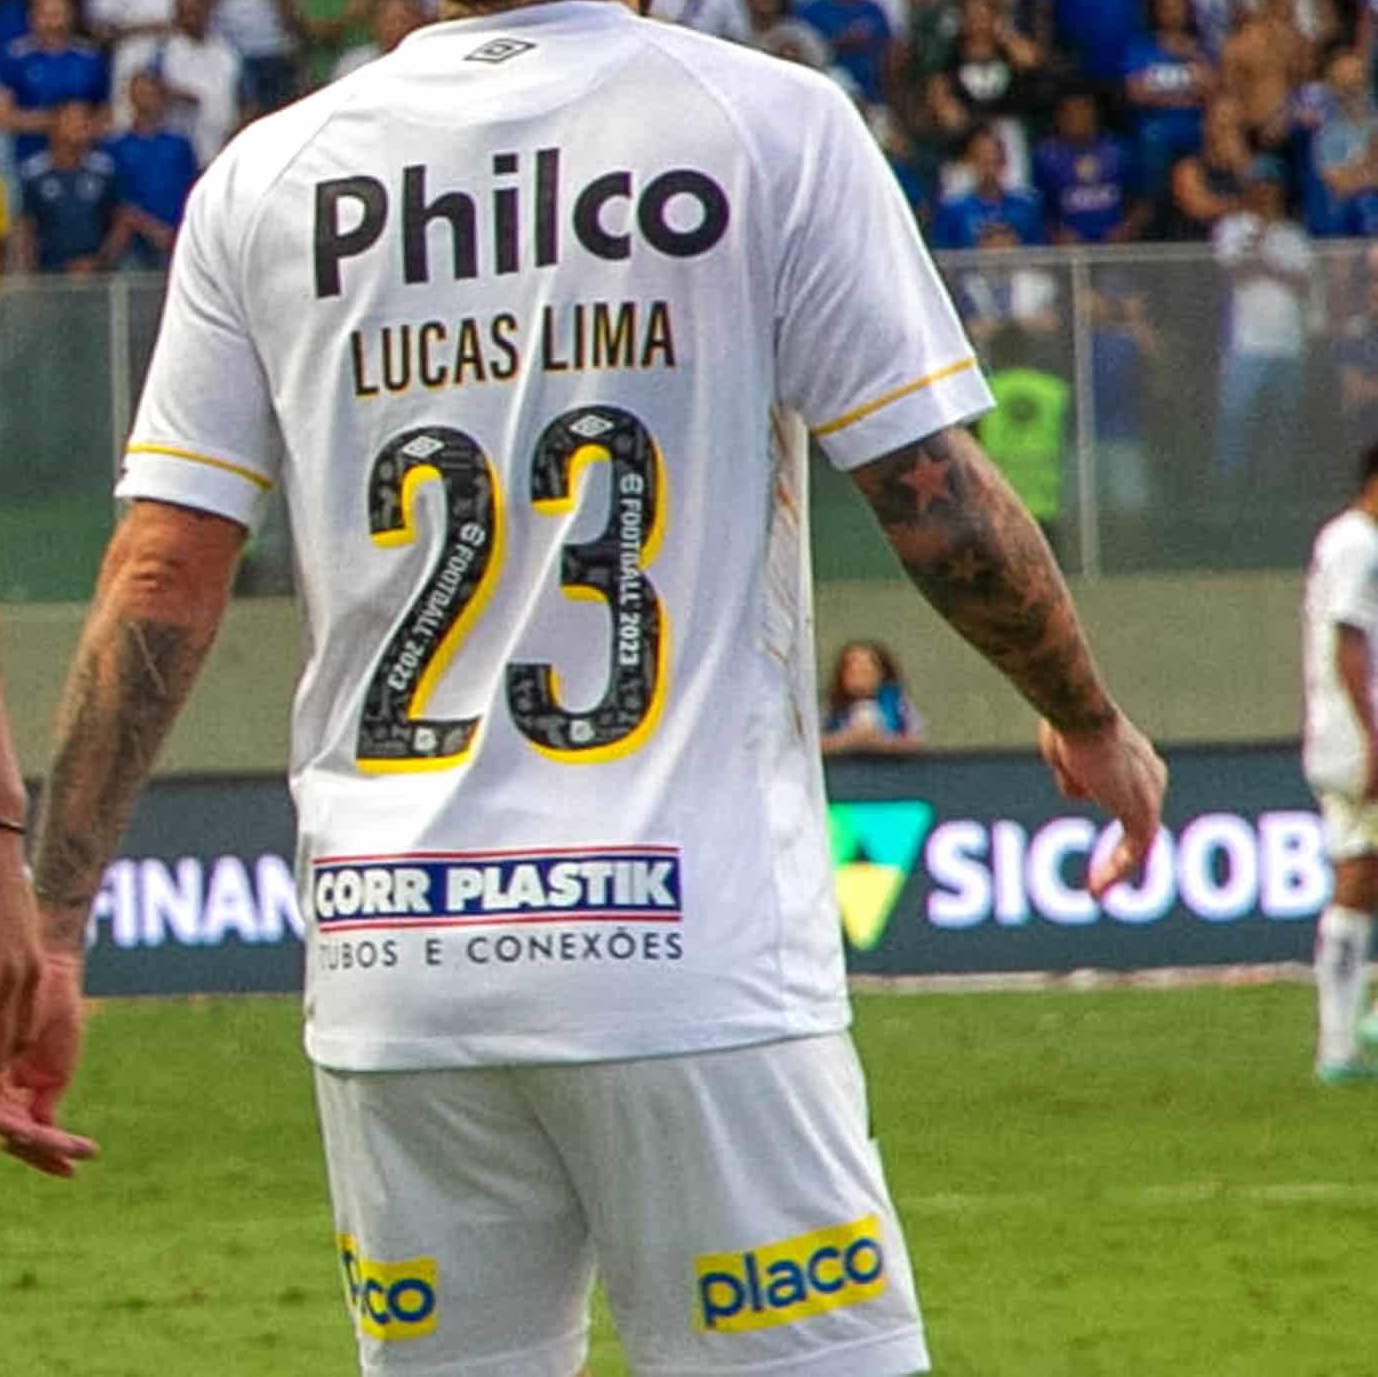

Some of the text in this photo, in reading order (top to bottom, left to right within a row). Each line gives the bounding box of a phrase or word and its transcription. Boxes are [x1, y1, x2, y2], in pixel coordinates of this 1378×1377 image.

[314, 147, 730, 298] Philco
[351, 301, 676, 396] LUCAS LIMA
[356, 405, 668, 778] 23
[387, 640, 426, 692] 2023
[618, 610, 641, 666] 2023
[85, 855, 307, 948] FINAN
[315, 858, 677, 918] CORR PLASTIK
[925, 811, 1335, 927] SICOOB
[425, 938, 442, 966] E
[467, 926, 683, 964] CONEXÕES
[700, 1236, 884, 1326] placo
